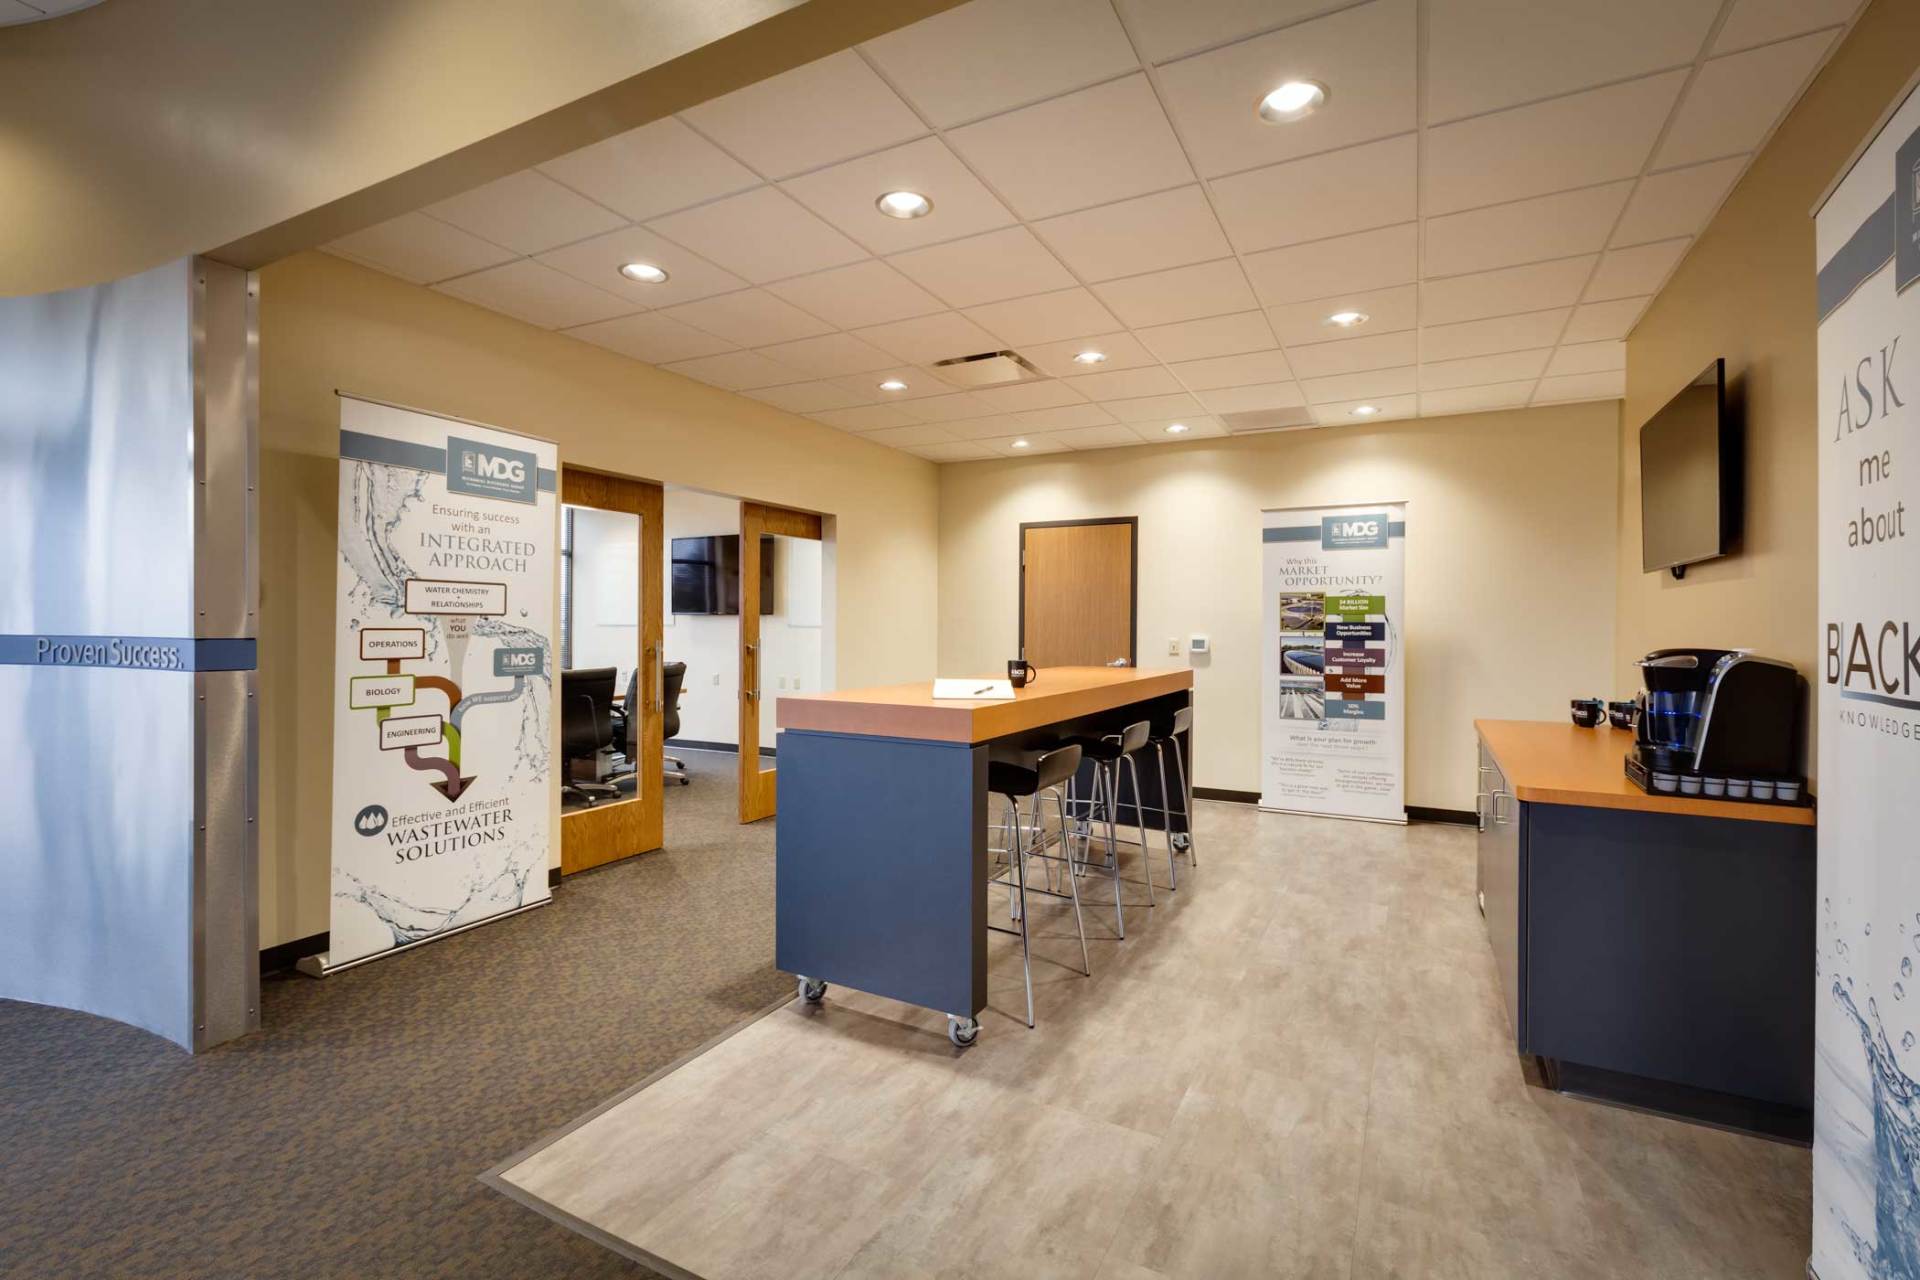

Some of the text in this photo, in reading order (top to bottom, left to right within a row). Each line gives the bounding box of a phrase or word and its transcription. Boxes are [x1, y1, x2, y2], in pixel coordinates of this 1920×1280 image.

[1833, 335, 1905, 443] ASK
[477, 453, 526, 483] MDG
[1859, 450, 1890, 487] me
[432, 503, 520, 525] Ensuring success
[451, 522, 491, 535] with an
[1342, 520, 1378, 537] MDG
[1848, 501, 1904, 548] about
[420, 532, 536, 557] INTEGRATED
[429, 552, 527, 573] APPROACH
[1280, 565, 1328, 576] MARKET
[424, 586, 489, 595] WATER CHEMISTRY
[1284, 575, 1383, 587] OPPORTUNITY?
[430, 600, 484, 609] RELATIONSHIPS
[449, 624, 467, 632] YOU
[37, 638, 184, 669] Proven Success.
[368, 640, 418, 648] OPERATIONS
[510, 653, 536, 668] MDG
[366, 687, 401, 697] BIOLOGY
[386, 726, 437, 739] ENGINEERING
[392, 797, 509, 828] Effective and Efficient
[387, 808, 513, 846] WASTEWATER
[395, 826, 505, 865] SOLUTIONS
